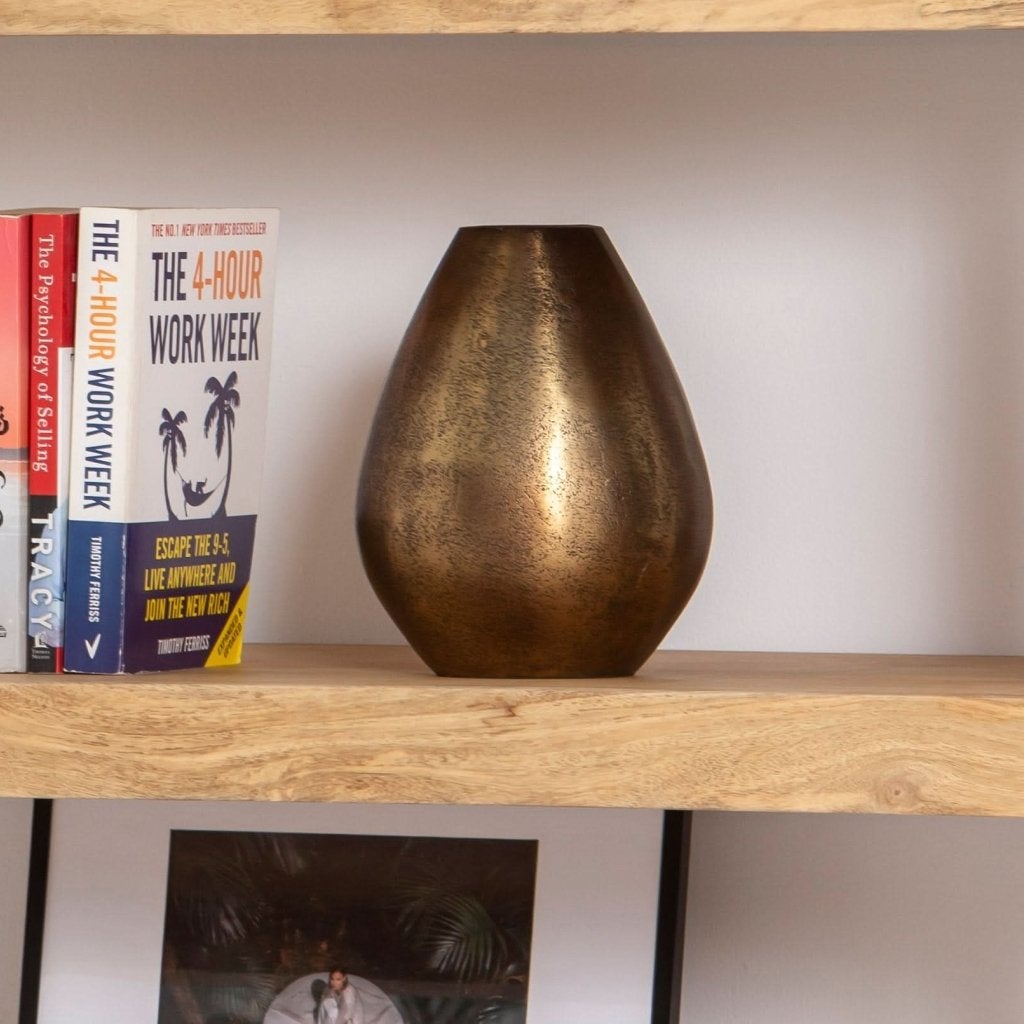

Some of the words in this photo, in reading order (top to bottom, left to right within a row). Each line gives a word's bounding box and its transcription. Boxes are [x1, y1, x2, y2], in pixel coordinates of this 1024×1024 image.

[92, 220, 120, 262] THE
[151, 223, 164, 237] THE
[181, 223, 195, 237] NEW
[197, 223, 212, 236] YORK
[214, 222, 232, 236] TIMES
[232, 221, 267, 236] BESTSELLER
[38, 234, 54, 269] The
[151, 251, 188, 302] THE
[192, 249, 264, 301] 4-HOUR
[33, 275, 54, 377] Psychology
[88, 269, 118, 360] 4-HOUR
[149, 313, 206, 365] WORK
[210, 312, 261, 363] WEEK
[38, 382, 53, 402] of
[85, 367, 116, 438] WORK
[32, 406, 53, 473] Selling
[83, 444, 113, 510] WEEK
[90, 536, 103, 579] TIMOTHY
[155, 536, 192, 560] ESCAPE
[194, 534, 211, 557] THE
[213, 532, 230, 557] 9-5,
[30, 513, 54, 630] TRACY
[144, 568, 166, 591] LIVE
[167, 564, 217, 589] ANYWHERE
[217, 562, 236, 584] AND
[88, 581, 101, 623] FERRISS
[144, 598, 166, 622] JOIN
[168, 596, 185, 619] THE
[186, 594, 207, 617] NEW
[207, 592, 231, 615] RICH
[158, 637, 184, 655] TIMOTHY
[184, 634, 210, 652] FERRISS
